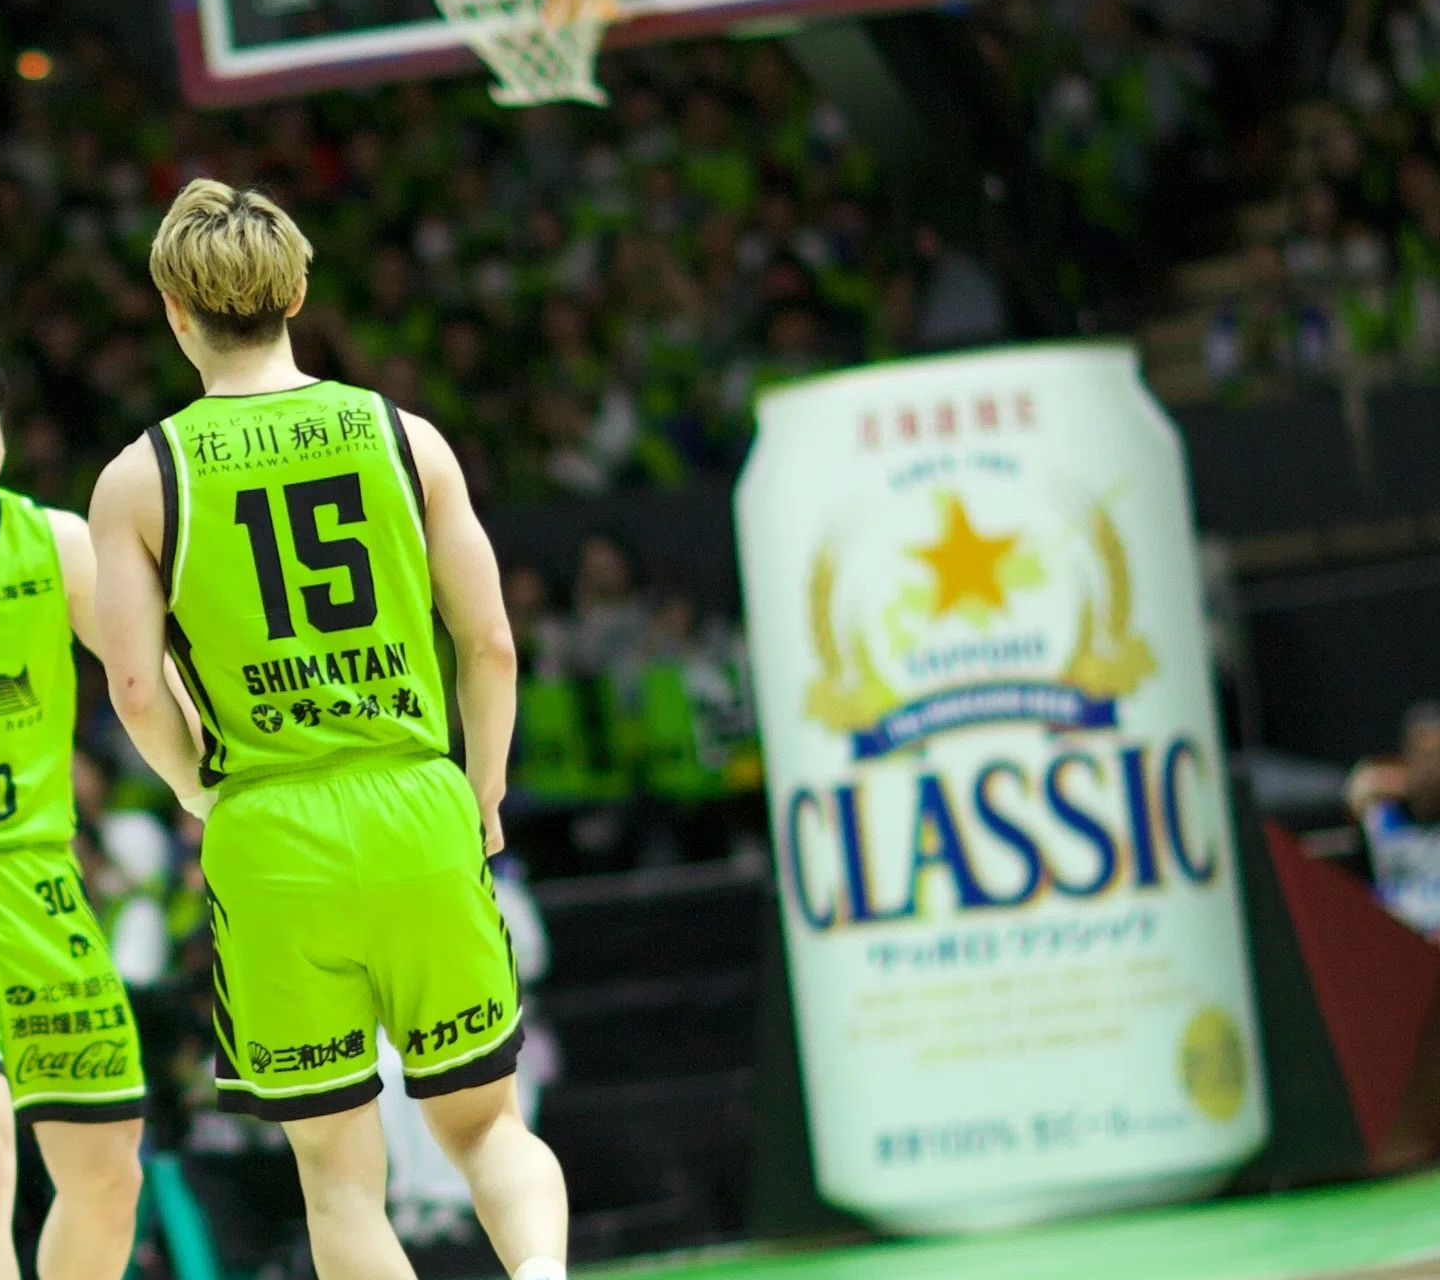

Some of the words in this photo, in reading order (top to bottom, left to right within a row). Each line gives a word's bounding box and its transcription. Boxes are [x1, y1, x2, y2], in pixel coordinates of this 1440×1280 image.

[185, 400, 368, 433] リハビリテーション
[189, 408, 376, 464] 花川病院
[197, 457, 290, 477] HANAKAWA
[299, 442, 379, 461] HOSPITAL
[234, 472, 378, 641] 15
[241, 641, 411, 696] SHIMATANI
[6, 710, 43, 731] head
[785, 734, 1217, 932] CLASSIC
[35, 876, 76, 917] 30
[273, 1029, 366, 1073] 三和水産
[406, 997, 504, 1056] オカでん
